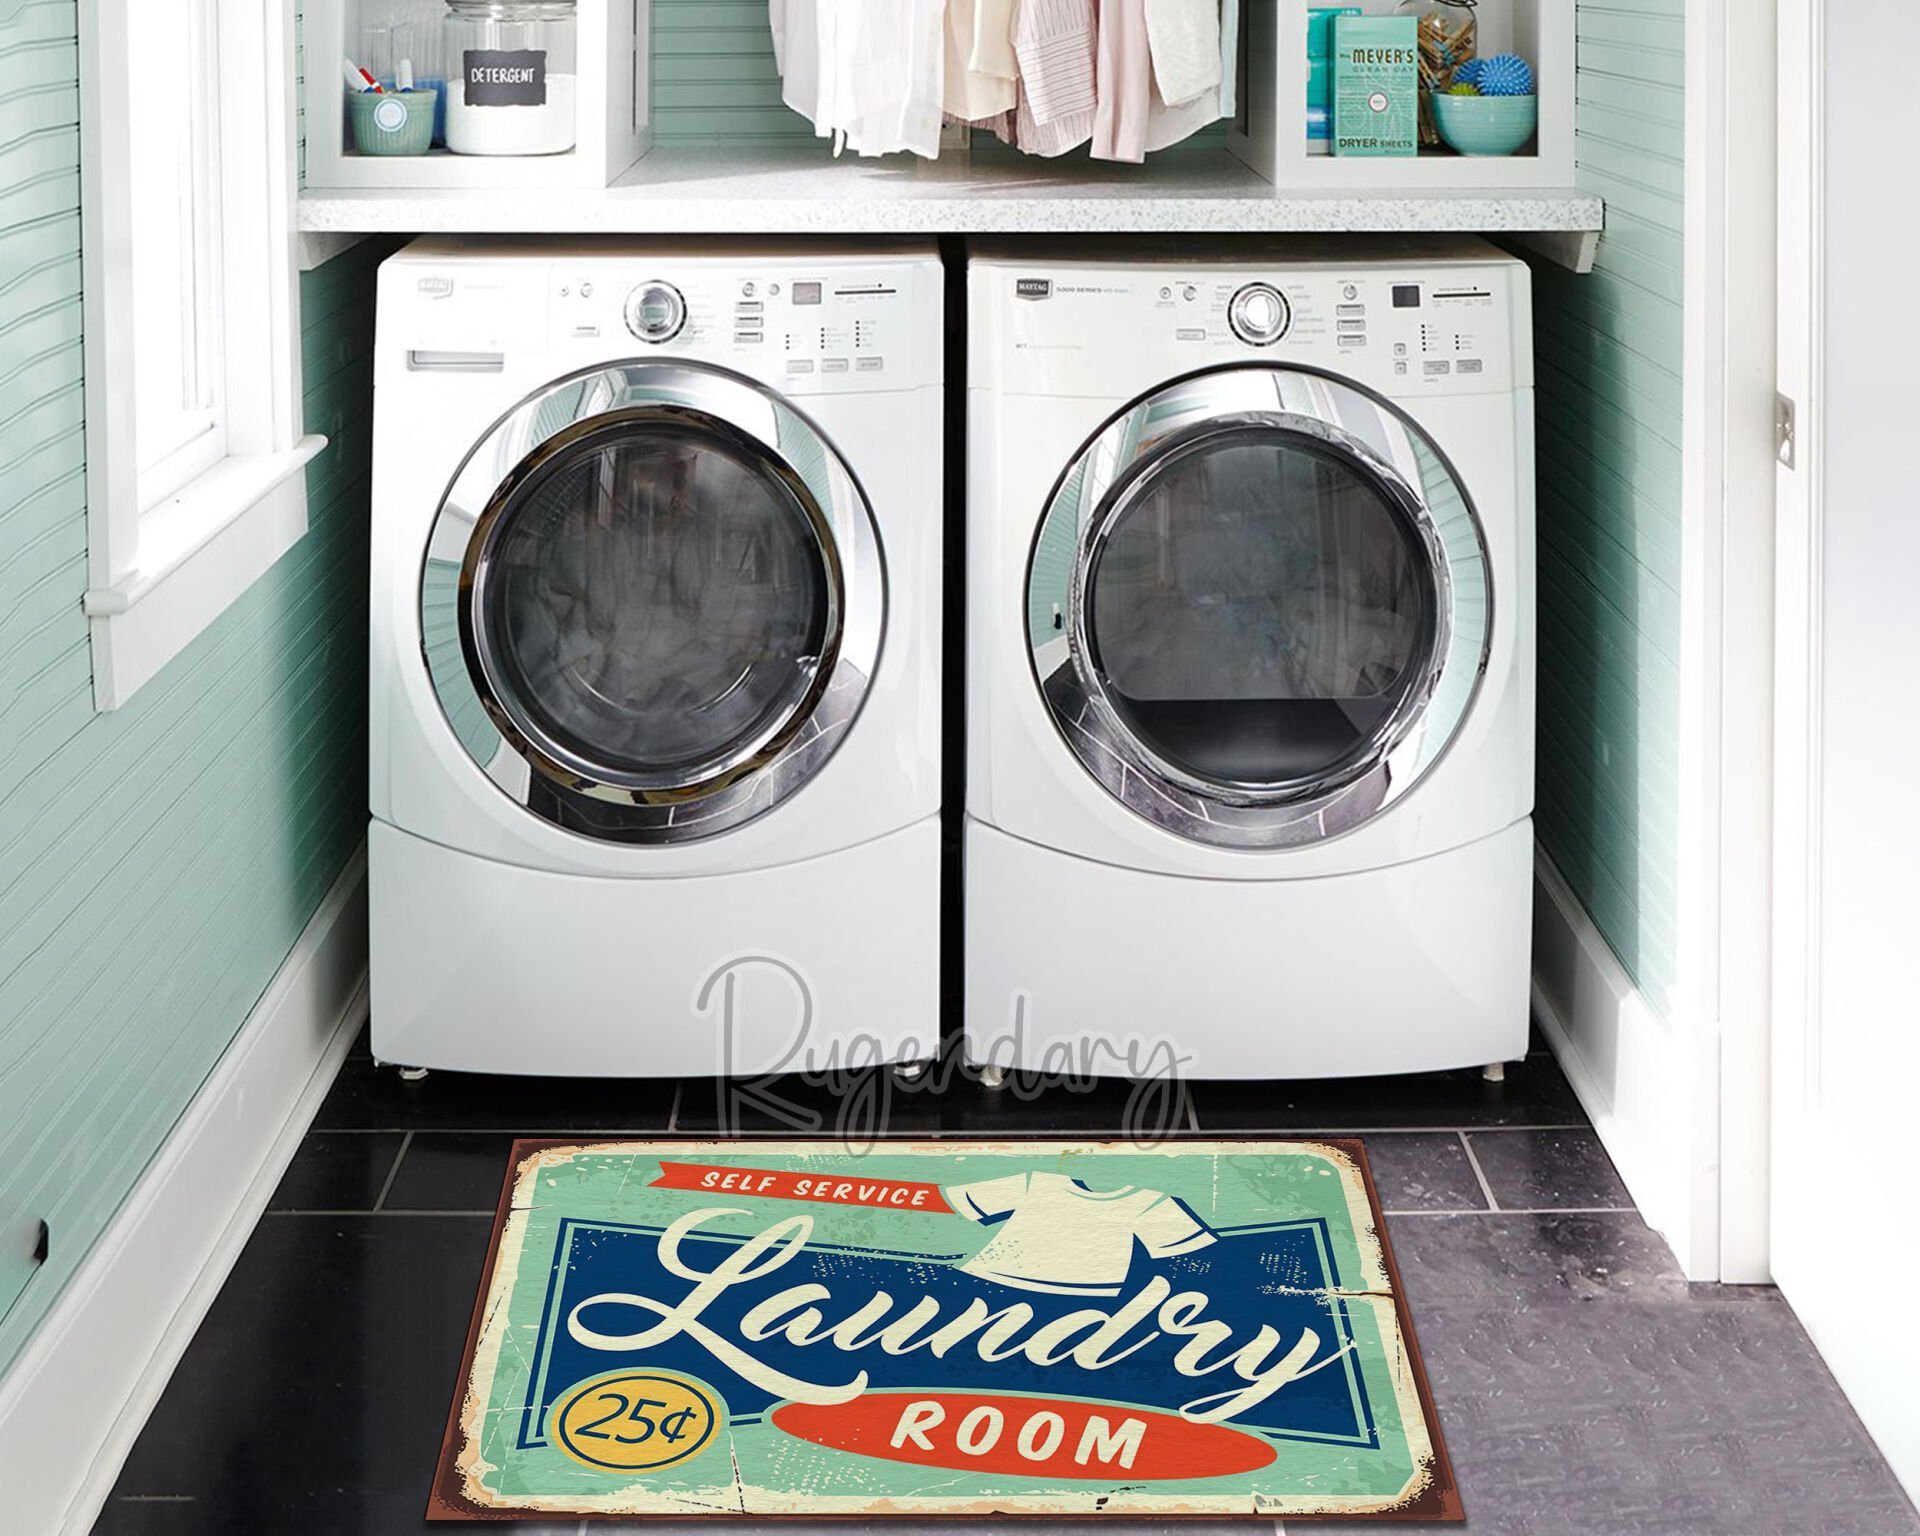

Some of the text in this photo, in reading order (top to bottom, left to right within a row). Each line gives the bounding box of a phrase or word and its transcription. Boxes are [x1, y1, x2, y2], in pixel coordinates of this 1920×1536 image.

[1353, 48, 1414, 64] MEYER'S
[471, 67, 535, 84] DETERGENT
[1339, 138, 1413, 148] DRYER SHEETS
[700, 1171, 930, 1206] SELF SERVICE
[567, 1207, 1359, 1424] Laundry
[573, 1392, 697, 1448] 25¢
[889, 1399, 1148, 1470] ROOM
